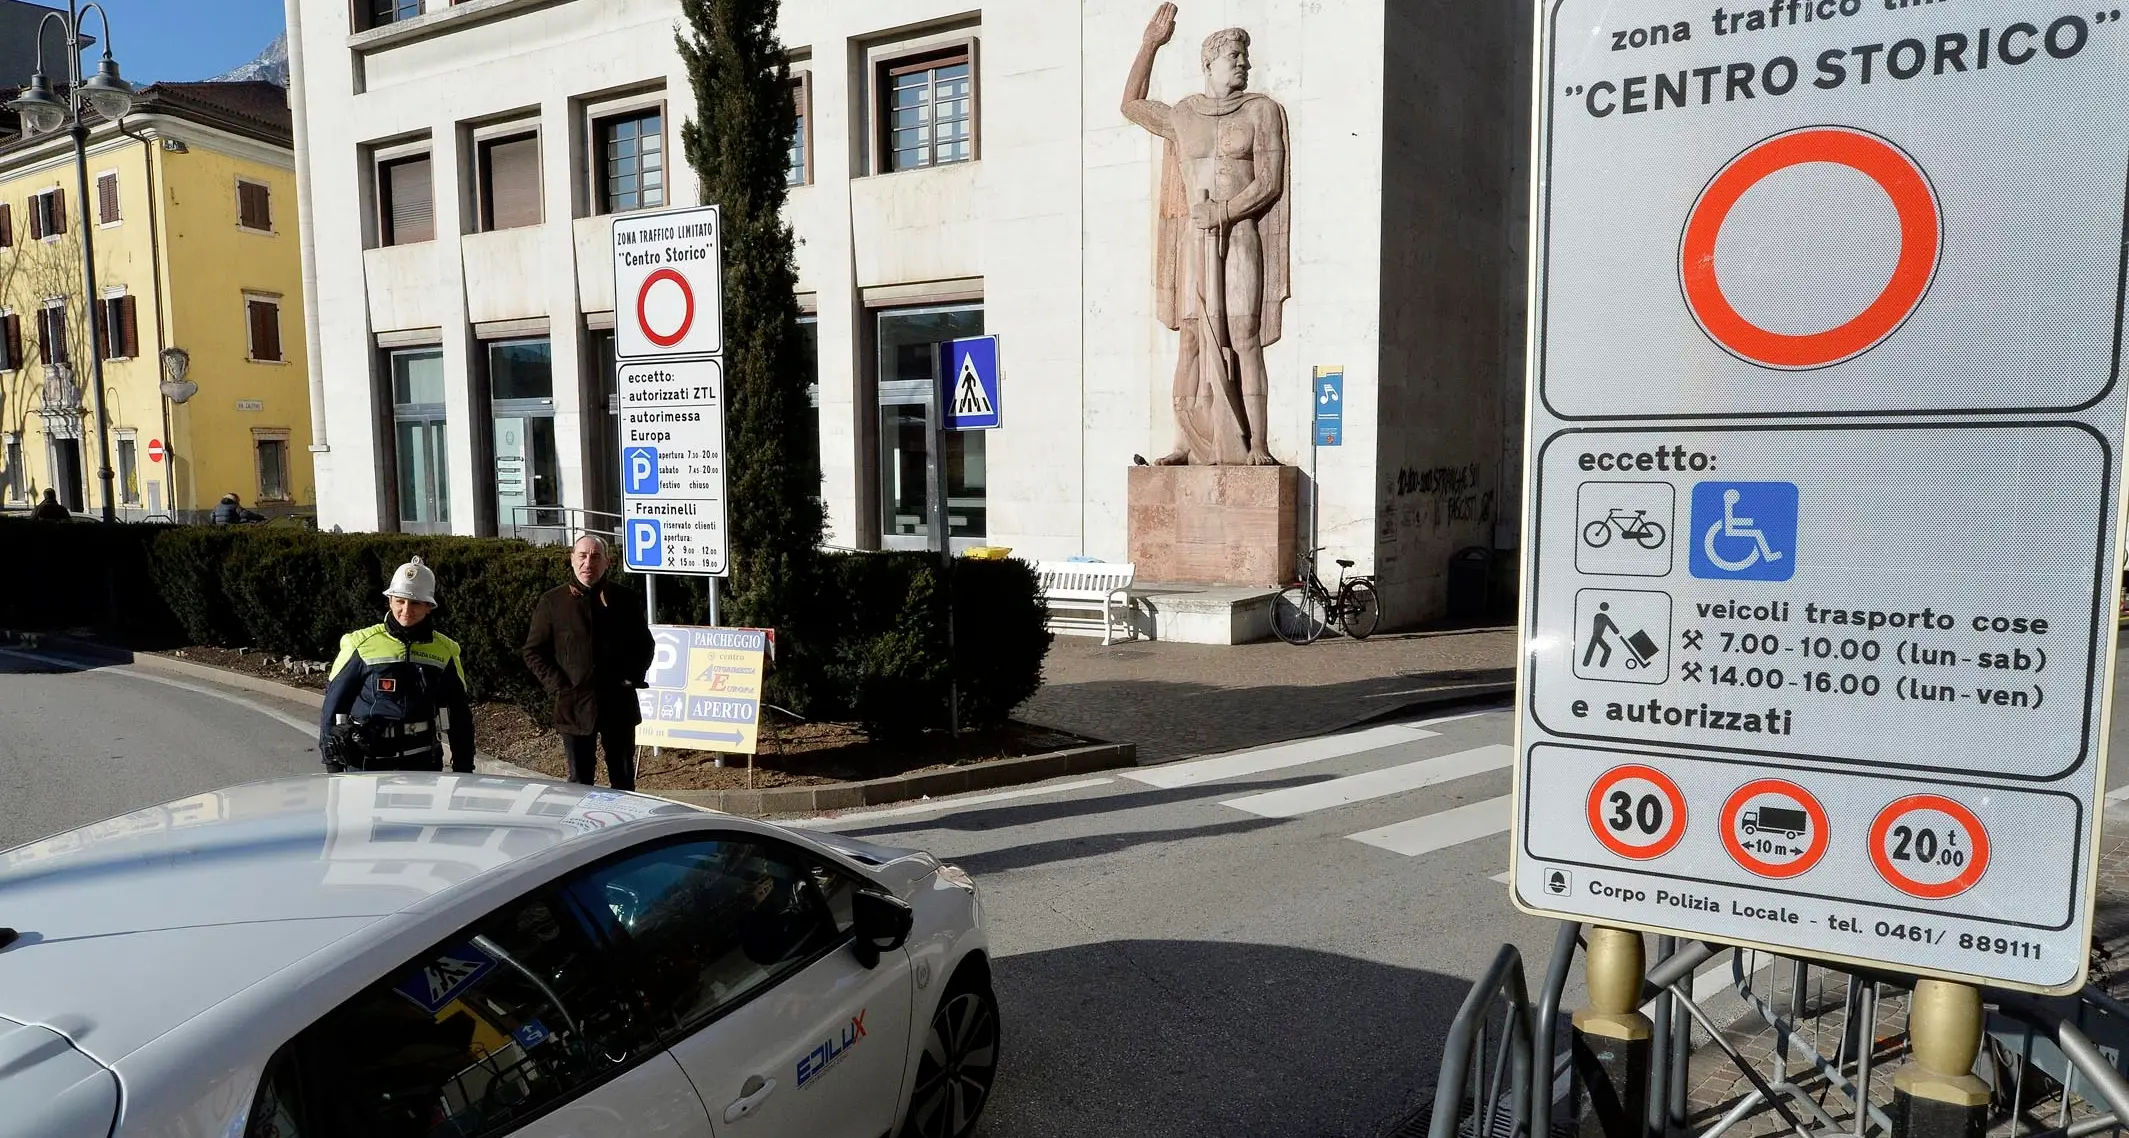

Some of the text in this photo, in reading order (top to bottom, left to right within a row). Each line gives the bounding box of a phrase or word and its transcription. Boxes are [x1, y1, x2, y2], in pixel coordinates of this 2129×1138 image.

[1611, 20, 1691, 51] zona
[617, 222, 713, 246] ZONA TRAFFICO LIMITATO
[628, 370, 675, 383] eccetto:
[629, 387, 689, 401] autorizzati
[693, 386, 716, 399] ZTL
[630, 410, 701, 423] autorimessa
[630, 429, 671, 443] Europa
[658, 450, 684, 460] apertura
[1577, 444, 1717, 472] eccetto:
[659, 465, 679, 474] sabato
[659, 480, 709, 489] festivo chiuso
[636, 502, 697, 515] Franzinelli
[663, 521, 716, 530] riservato clienti
[1696, 601, 2049, 635] veicoli trasporto cose
[694, 632, 761, 649] PARCHEGGIO
[692, 700, 752, 720] APERTO
[1570, 700, 1793, 736] e autorizzati
[1608, 790, 1664, 834] 30
[1947, 829, 1957, 847] t
[1756, 839, 1787, 856] 10 m
[1588, 879, 1646, 905] Corpo
[1656, 889, 1720, 914] Polizia
[1732, 901, 1800, 925] Locale
[1828, 913, 1863, 935] tel.
[1875, 920, 1946, 947] 0461/
[1959, 932, 2042, 960] 889111
[796, 1008, 867, 1087] EDILUX
